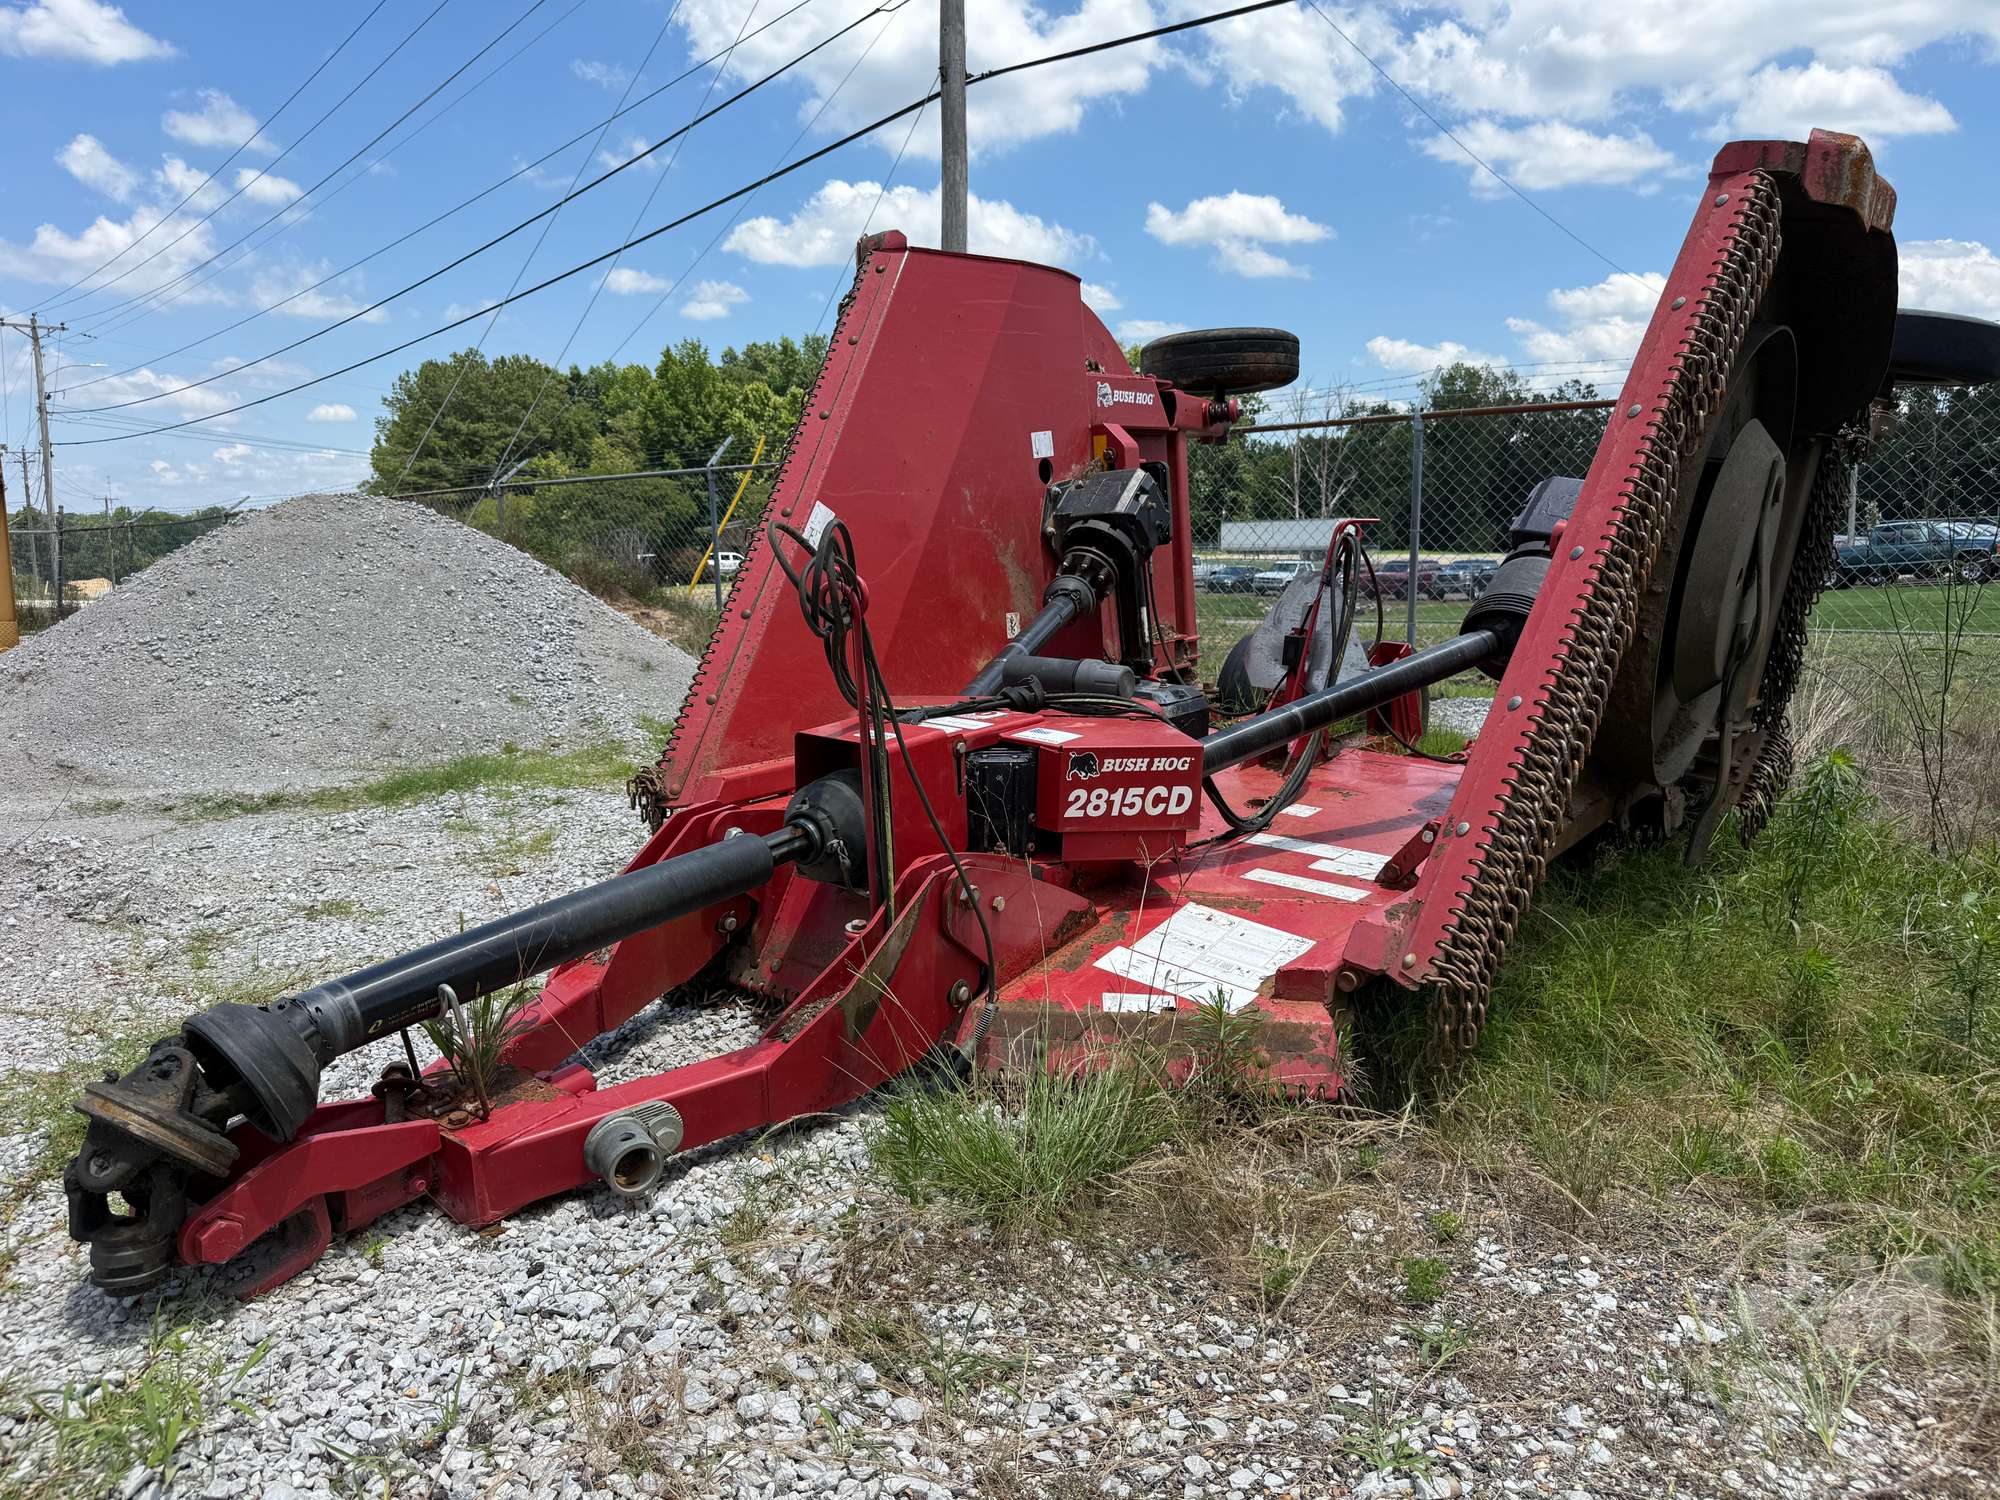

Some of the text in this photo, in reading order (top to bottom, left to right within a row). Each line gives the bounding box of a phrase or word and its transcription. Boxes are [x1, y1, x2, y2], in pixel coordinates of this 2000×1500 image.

[1113, 390, 1153, 405] BUSH HOG
[1101, 757, 1191, 772] BUSH HOG
[1063, 785, 1193, 818] 2815CD
